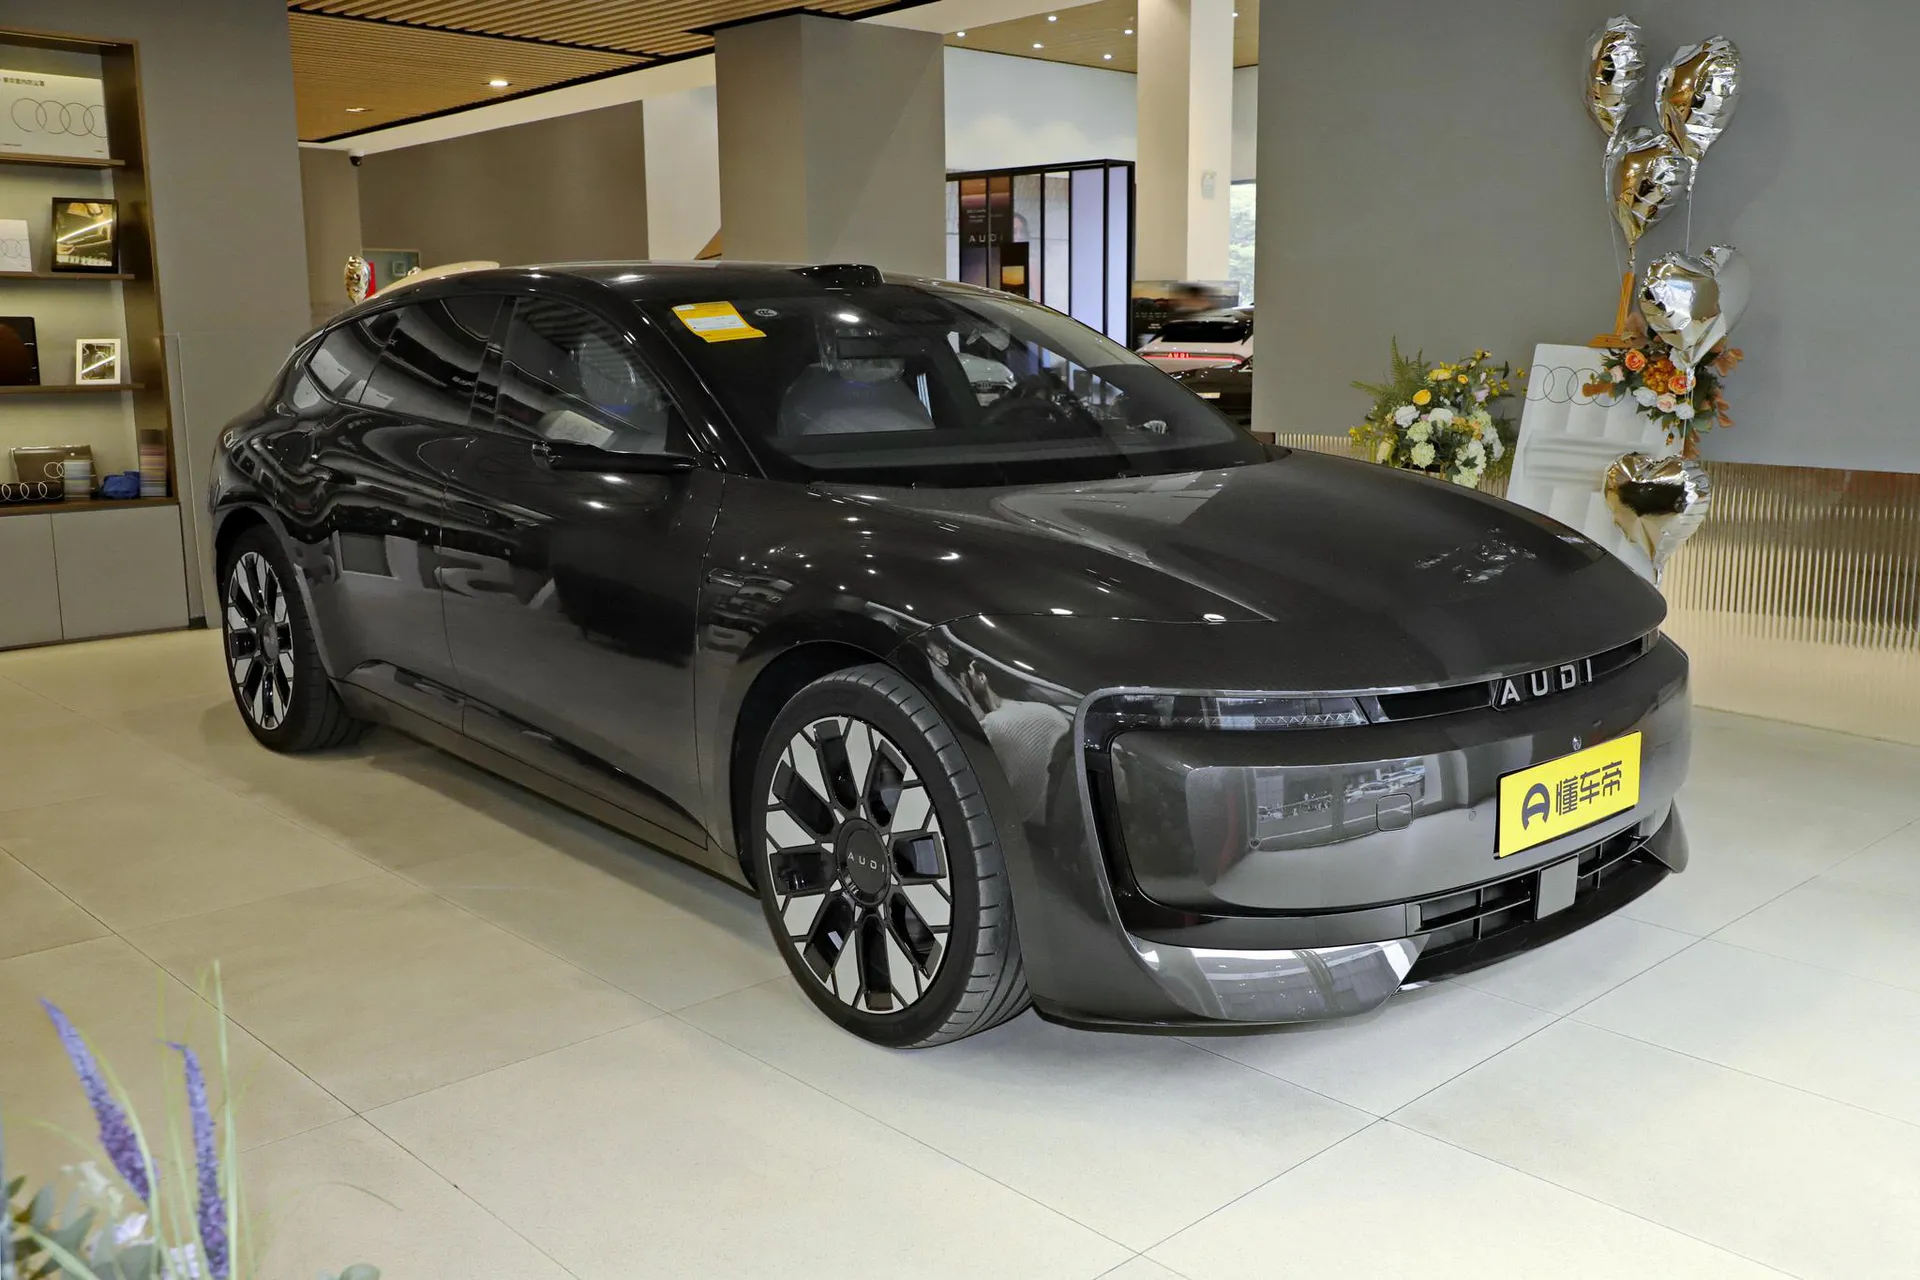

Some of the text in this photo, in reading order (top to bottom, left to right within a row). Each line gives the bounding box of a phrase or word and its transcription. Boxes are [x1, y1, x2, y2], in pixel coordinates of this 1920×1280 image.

[1501, 658, 1593, 705] AUDI
[1555, 760, 1623, 815] 懂车帝
[847, 852, 885, 873] AUDI
